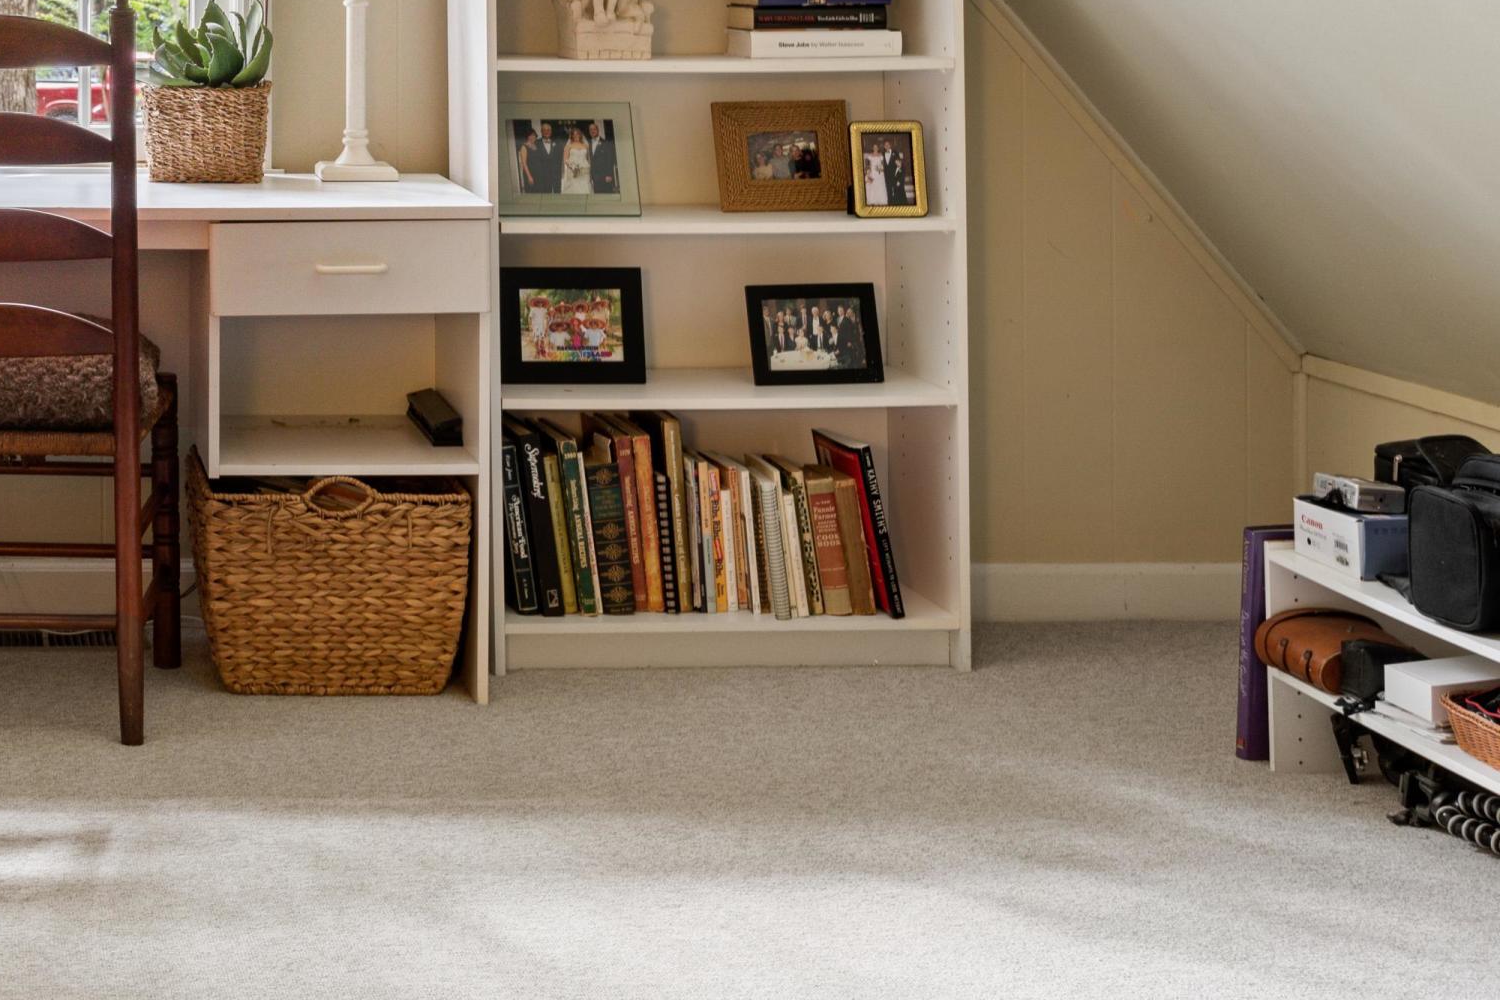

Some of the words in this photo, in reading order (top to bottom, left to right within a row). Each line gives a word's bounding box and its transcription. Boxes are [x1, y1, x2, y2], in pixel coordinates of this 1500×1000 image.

[511, 493, 524, 537] American
[574, 513, 583, 539] ANNUAL
[627, 510, 636, 536] ANNUAL
[1301, 514, 1323, 529] Canon
[517, 536, 527, 558] Food
[816, 533, 840, 541] COOK
[866, 468, 878, 495] KATHY
[872, 498, 887, 535] SMITH'S
[892, 594, 901, 614] WEIGHT
[578, 540, 587, 568] RECIPES
[630, 537, 639, 564] RECIPES
